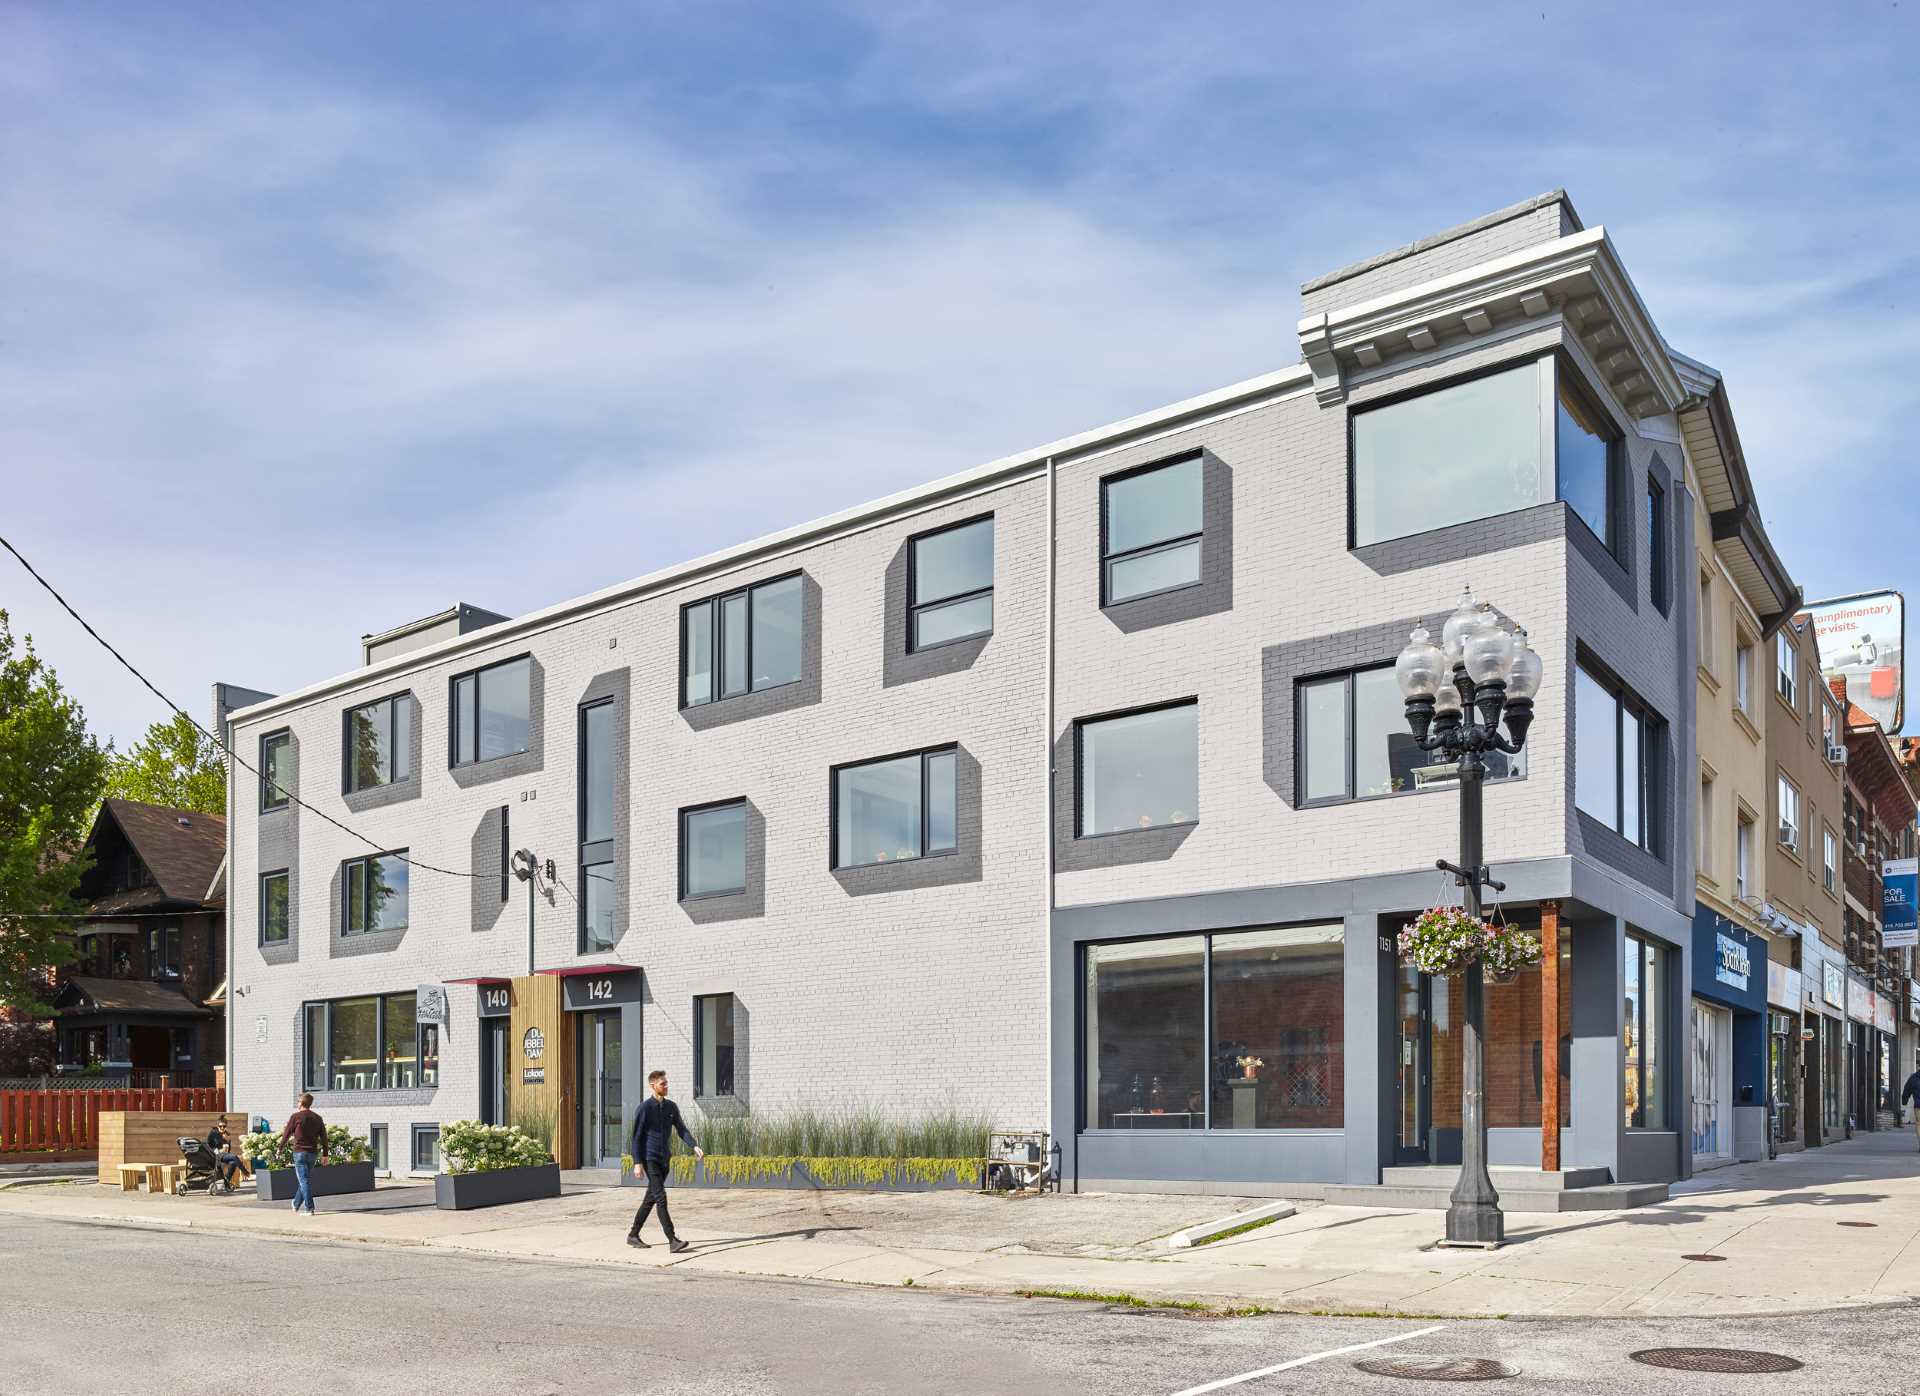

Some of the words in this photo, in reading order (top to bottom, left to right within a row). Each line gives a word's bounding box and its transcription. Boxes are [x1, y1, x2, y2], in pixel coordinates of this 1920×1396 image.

[1884, 888, 1904, 896] FOR
[1884, 895, 1906, 903] SALE
[1379, 935, 1391, 953] 1151
[486, 989, 508, 1008] 140
[587, 980, 613, 1000] 142
